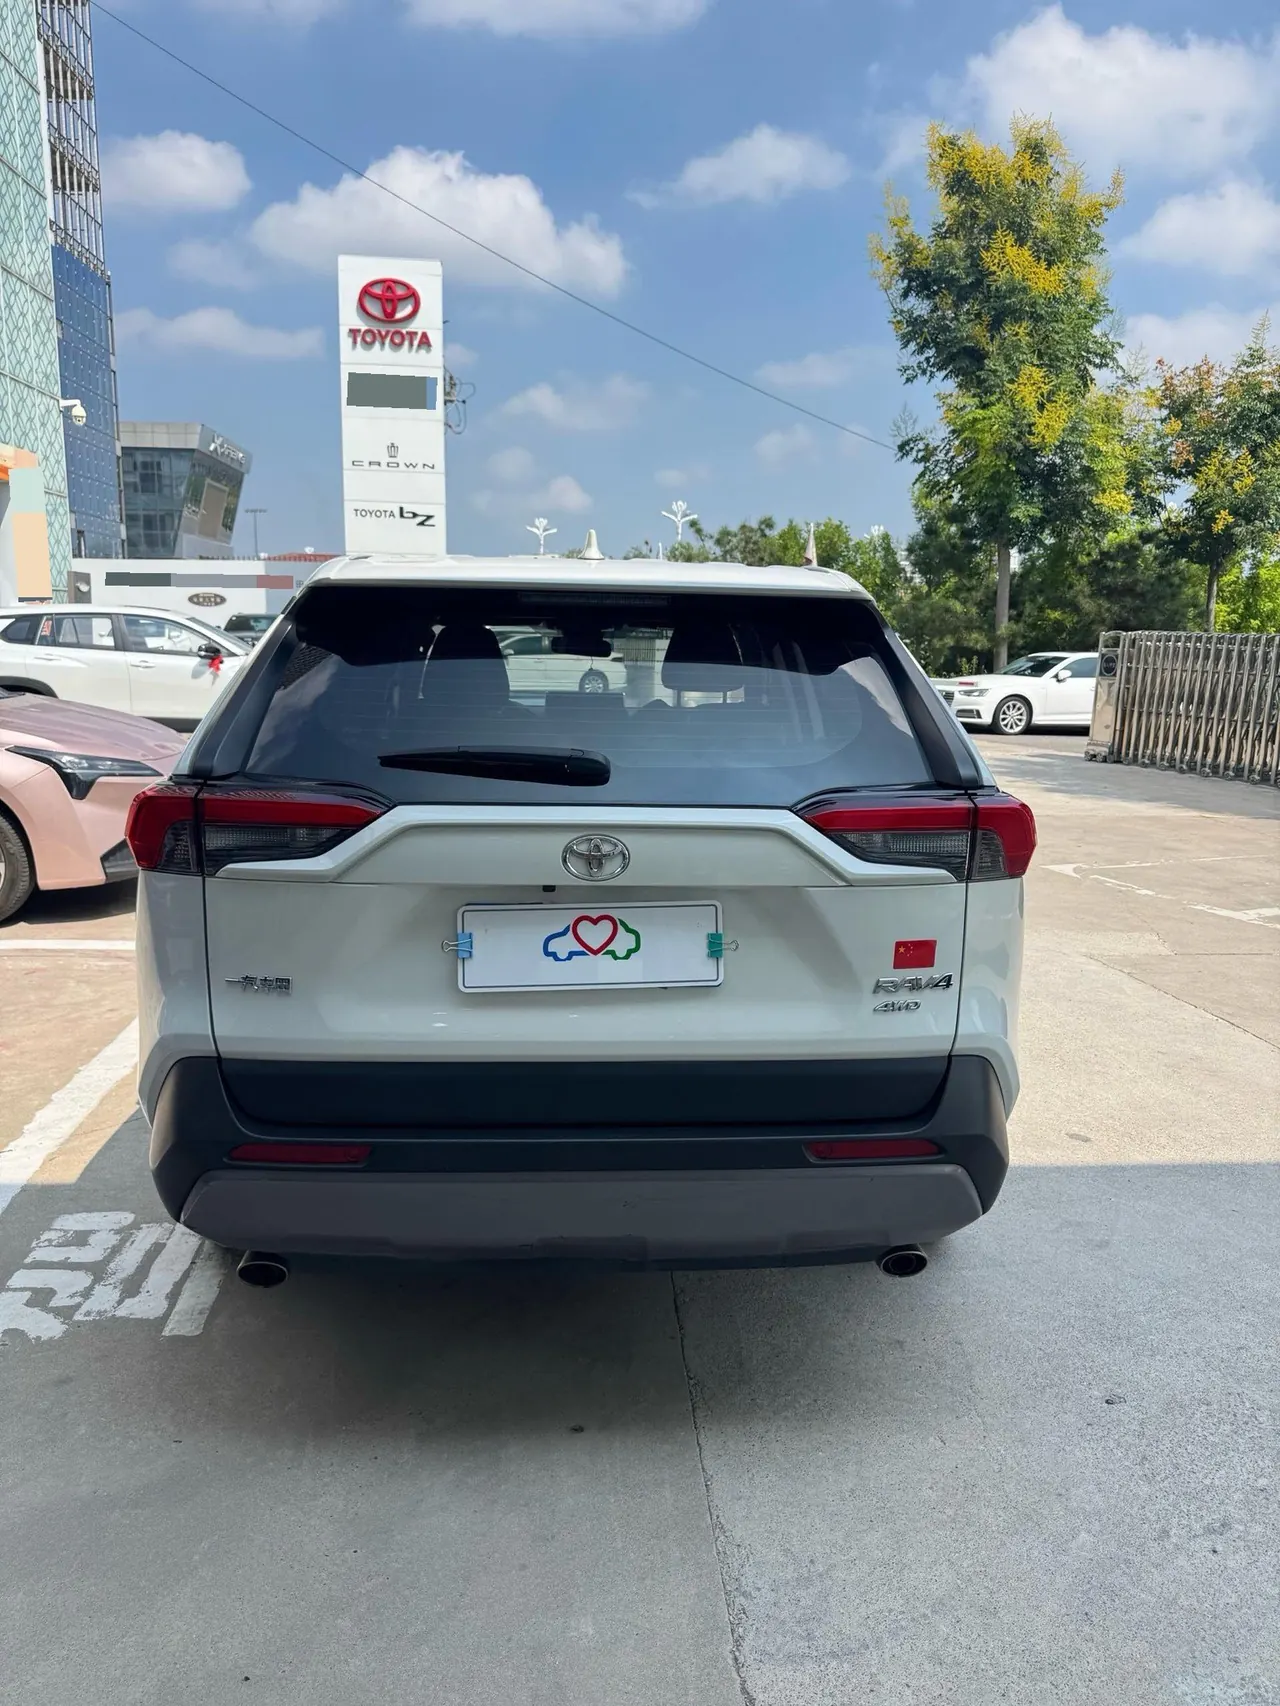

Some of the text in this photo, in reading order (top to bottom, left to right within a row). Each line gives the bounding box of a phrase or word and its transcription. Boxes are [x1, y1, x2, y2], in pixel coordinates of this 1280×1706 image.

[348, 328, 432, 349] TOYOTA
[352, 460, 435, 470] CROWN
[353, 508, 396, 519] TOYOTA
[872, 972, 954, 994] RAV4
[873, 999, 922, 1012] 4WD
